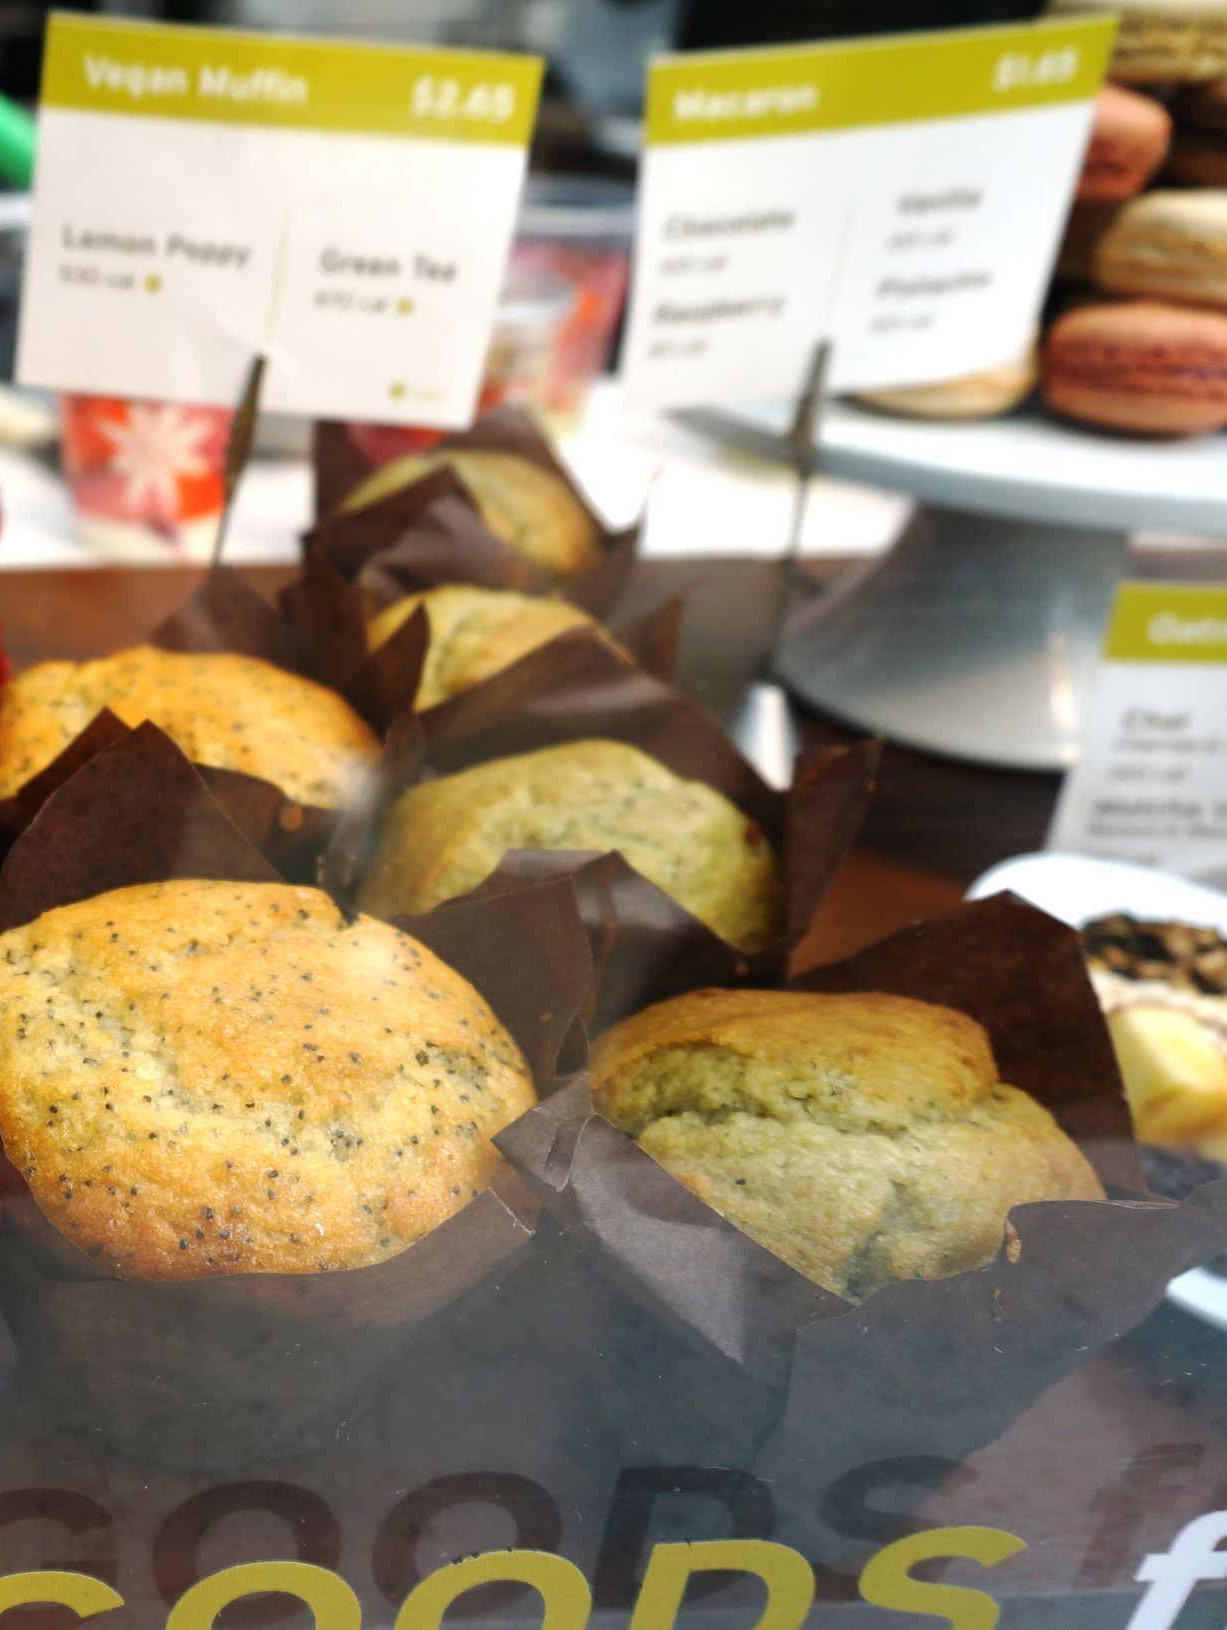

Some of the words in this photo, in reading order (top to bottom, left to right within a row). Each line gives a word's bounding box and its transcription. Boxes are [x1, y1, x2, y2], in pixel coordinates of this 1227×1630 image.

[82, 54, 187, 97] Vegan
[198, 65, 308, 105] Muffin
[411, 75, 516, 123] $2.65
[673, 84, 820, 122] Macaron
[664, 208, 795, 243] Chocolate
[61, 224, 155, 257] Lemon
[165, 233, 251, 272] Poppy
[319, 248, 399, 278] Green
[413, 255, 457, 283] Tea
[654, 296, 785, 330] Raspberry
